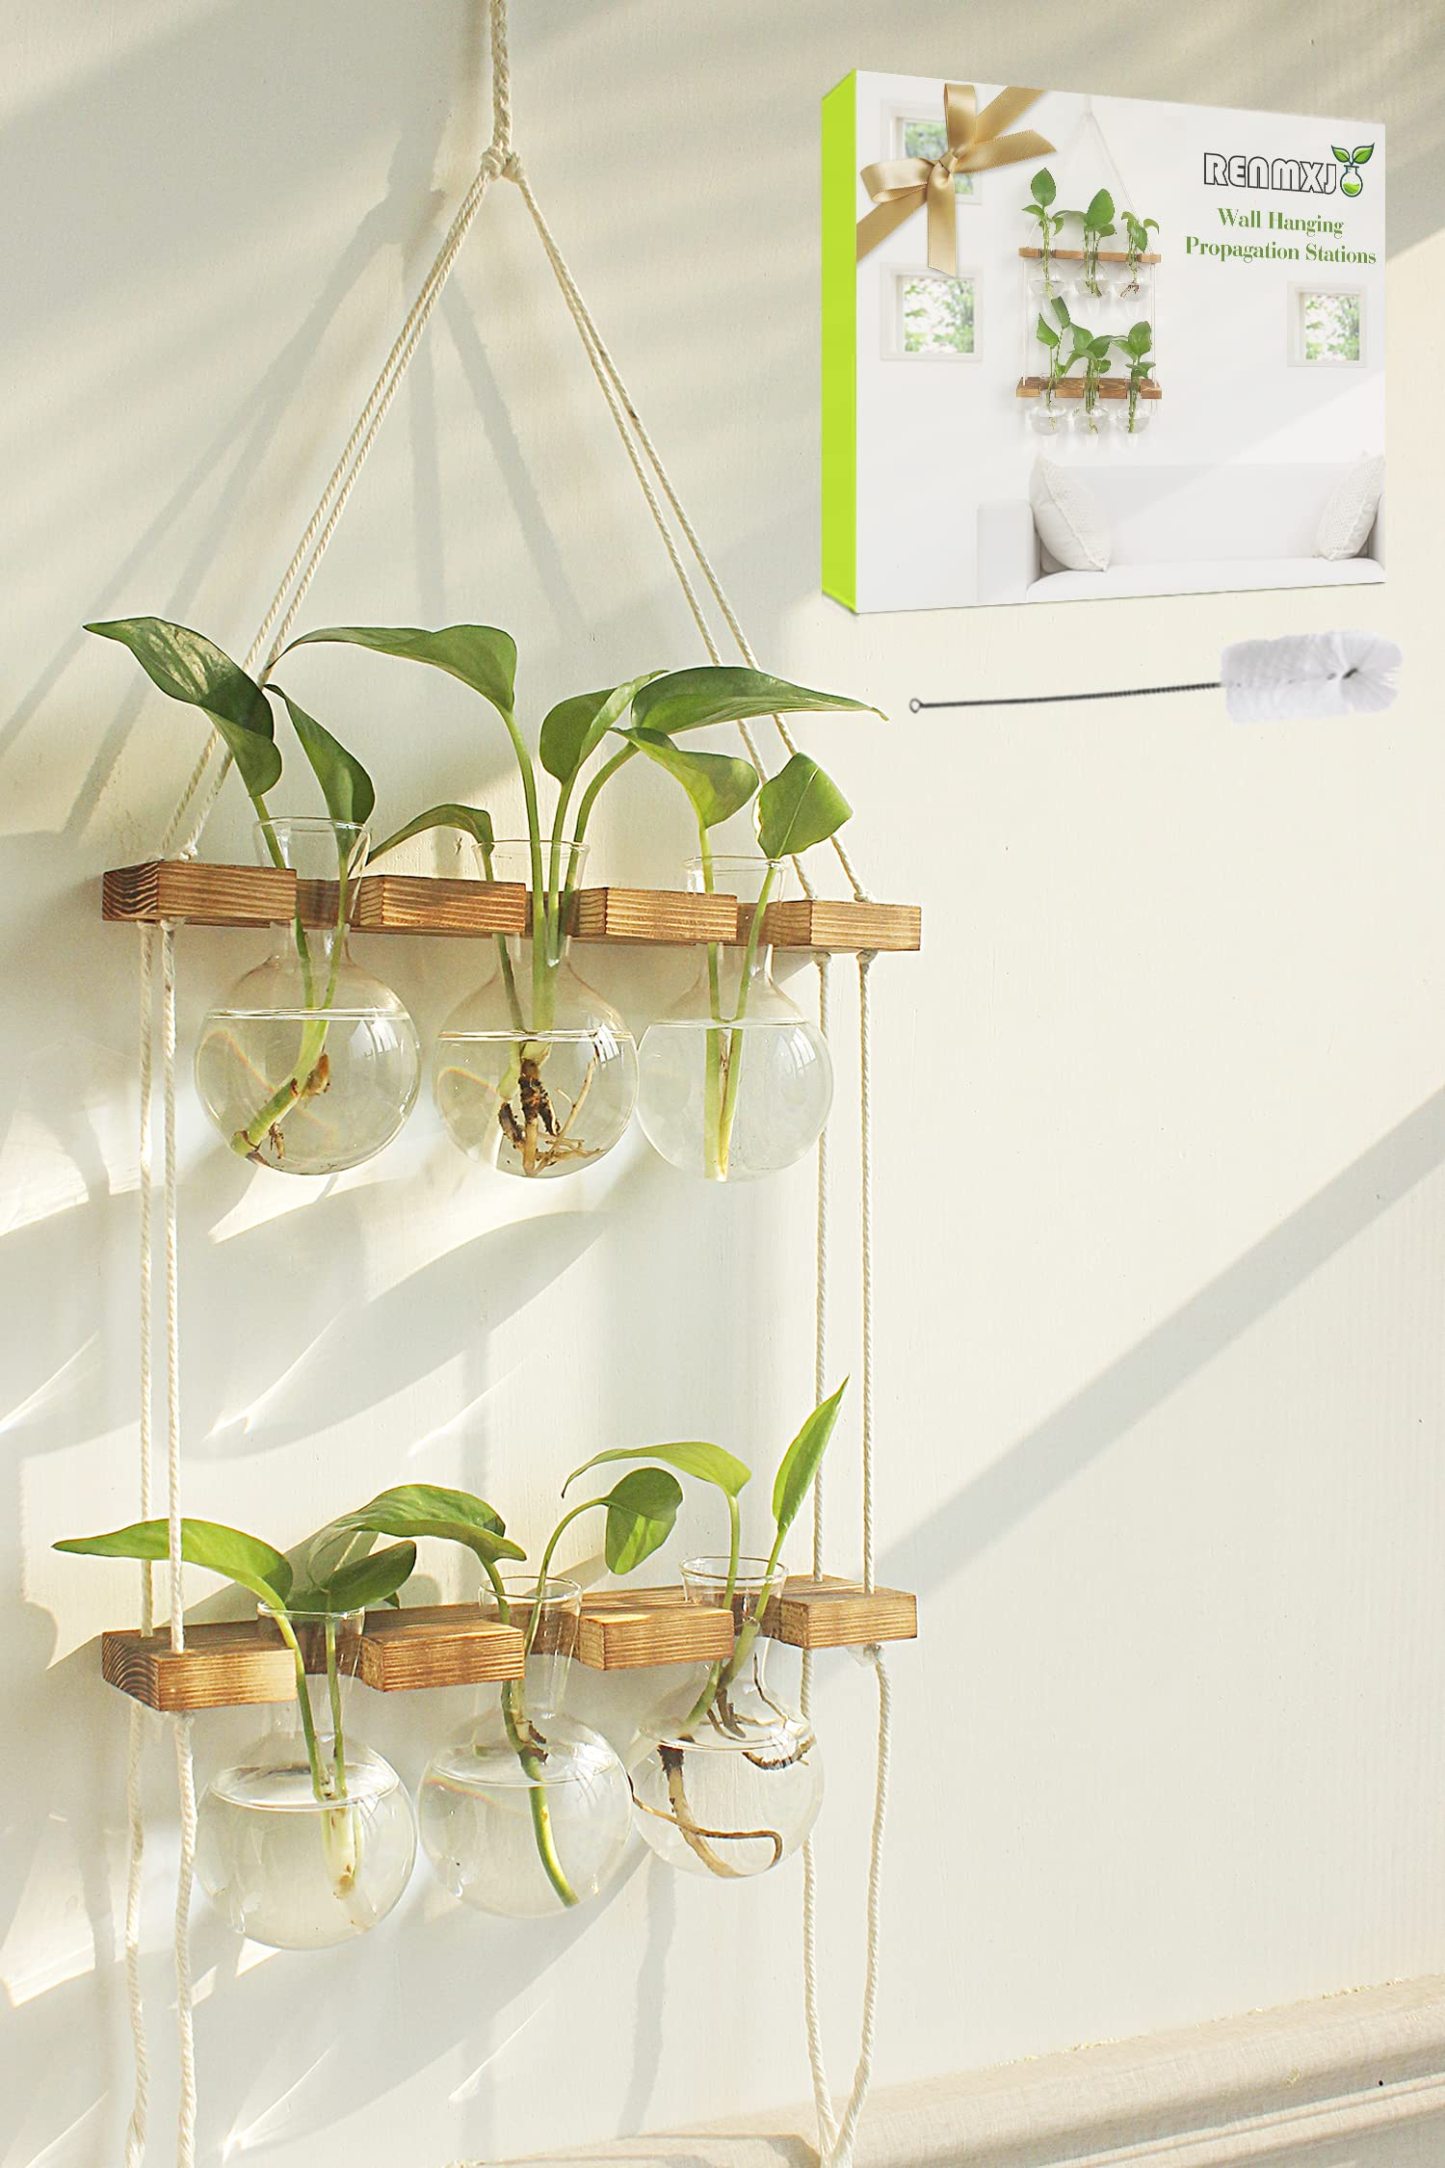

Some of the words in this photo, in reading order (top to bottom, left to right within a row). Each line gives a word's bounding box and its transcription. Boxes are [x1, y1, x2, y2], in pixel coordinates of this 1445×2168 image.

[1216, 207, 1261, 229] Wall
[1268, 211, 1345, 240] Hanging
[1184, 235, 1300, 264] Propagation
[1305, 242, 1377, 265] Stations
